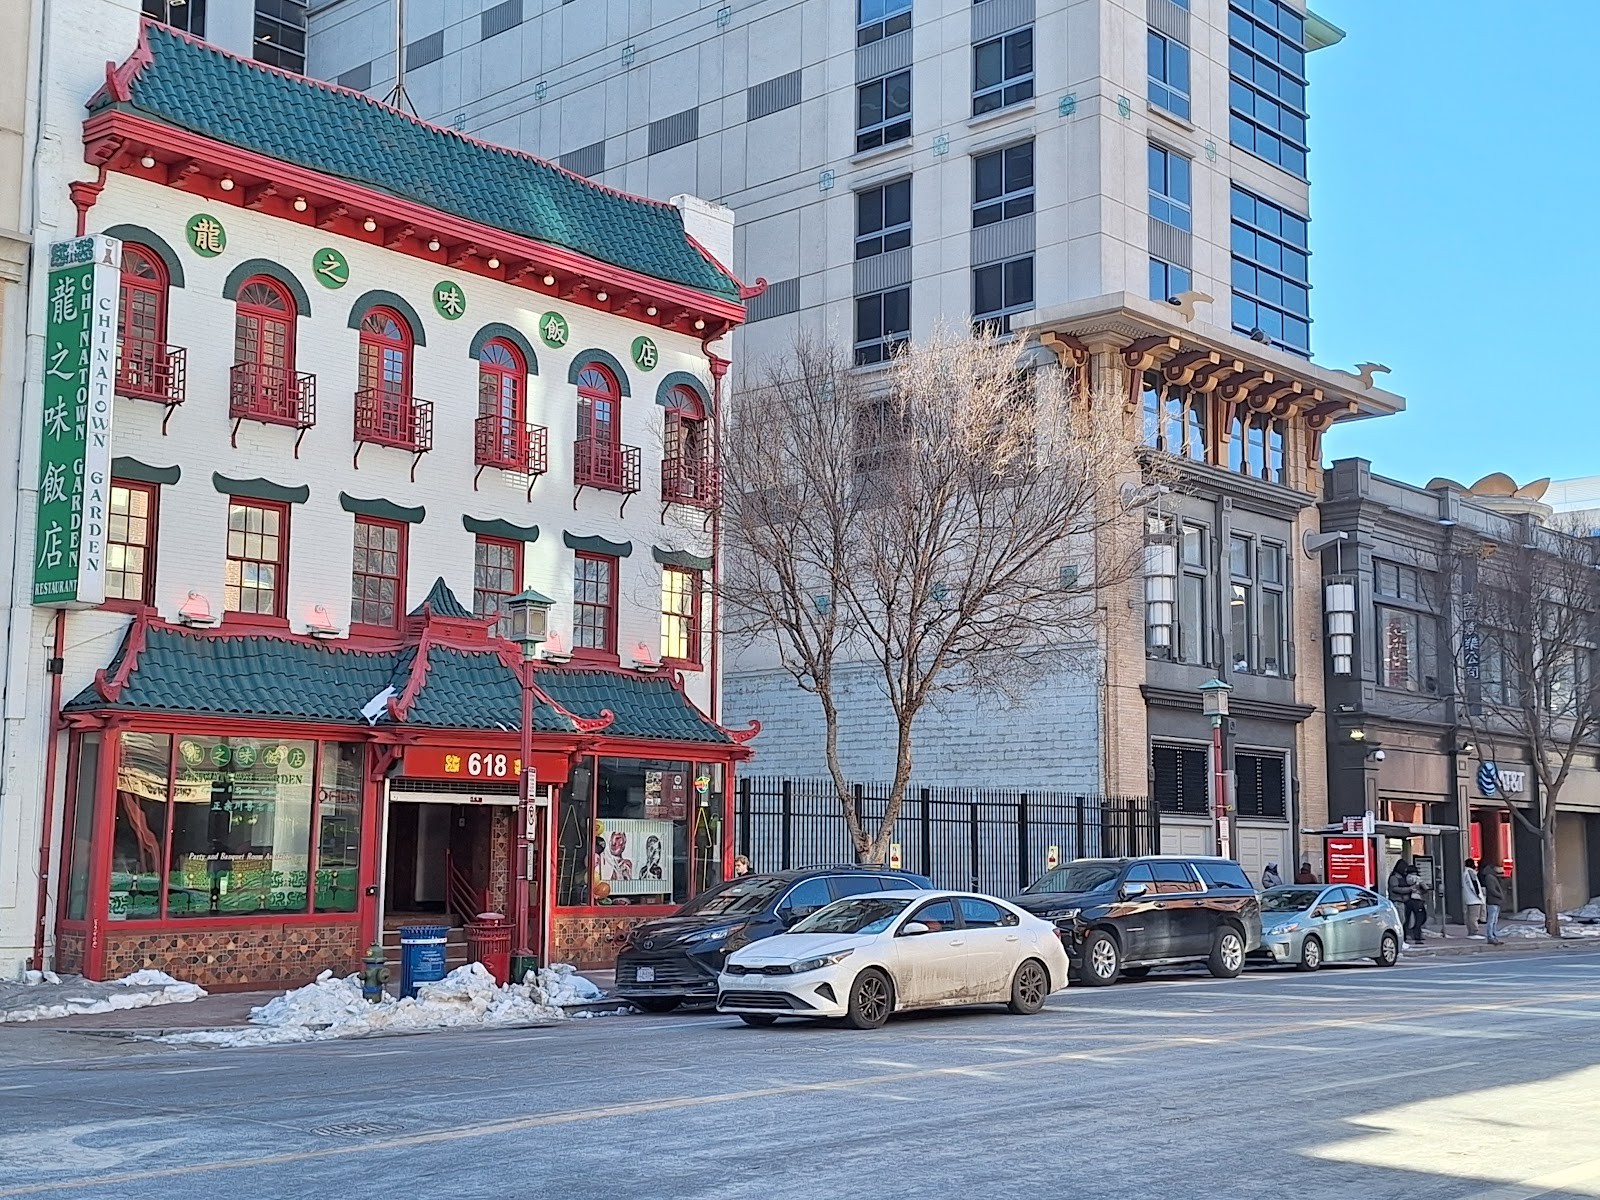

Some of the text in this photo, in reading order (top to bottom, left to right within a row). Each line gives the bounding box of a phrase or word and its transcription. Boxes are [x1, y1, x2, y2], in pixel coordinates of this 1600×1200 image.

[38, 276, 77, 570] 龍之味飯店
[68, 274, 92, 567] CHINATOWN GARDEN
[87, 298, 111, 571] CHINATOWN GARDEN
[35, 579, 77, 595] RESTAURANT
[467, 752, 507, 777] 618
[1497, 770, 1525, 792] AT&T
[189, 852, 205, 861] Party
[207, 852, 219, 860] and
